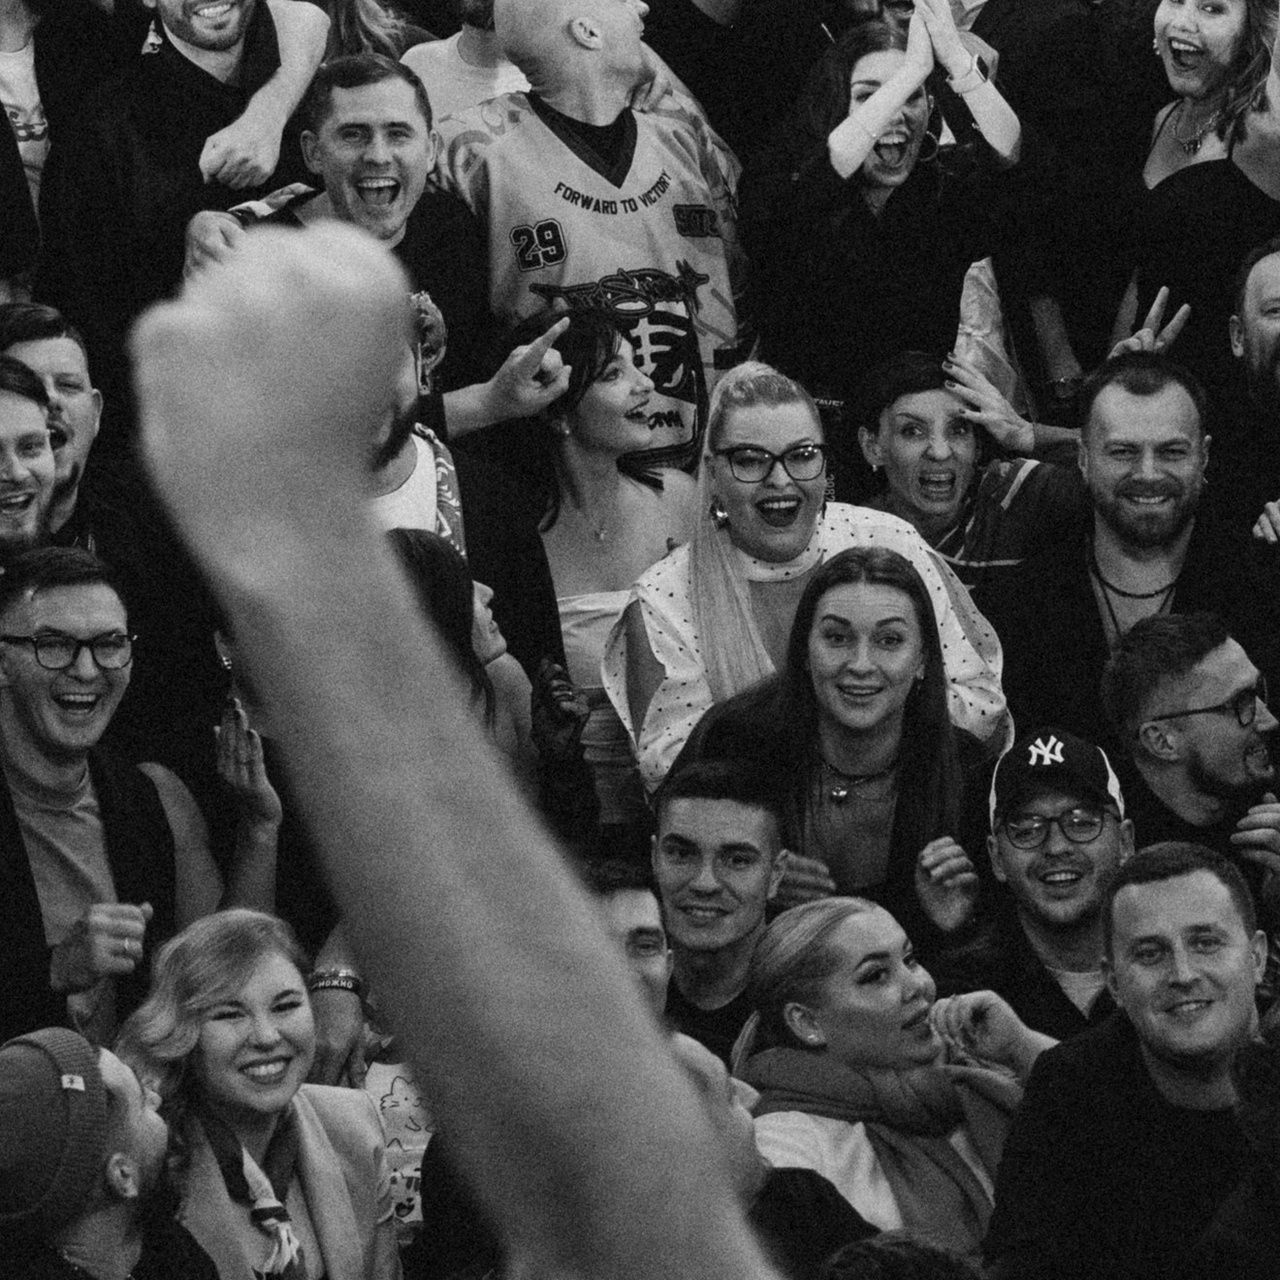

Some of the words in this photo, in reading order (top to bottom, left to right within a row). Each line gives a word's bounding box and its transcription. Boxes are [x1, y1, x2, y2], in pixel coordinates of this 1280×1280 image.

[553, 181, 618, 215] FORWARD
[620, 197, 639, 215] TO
[638, 169, 672, 208] VICTORY
[510, 219, 567, 272] 29
[1028, 735, 1065, 766] NY
